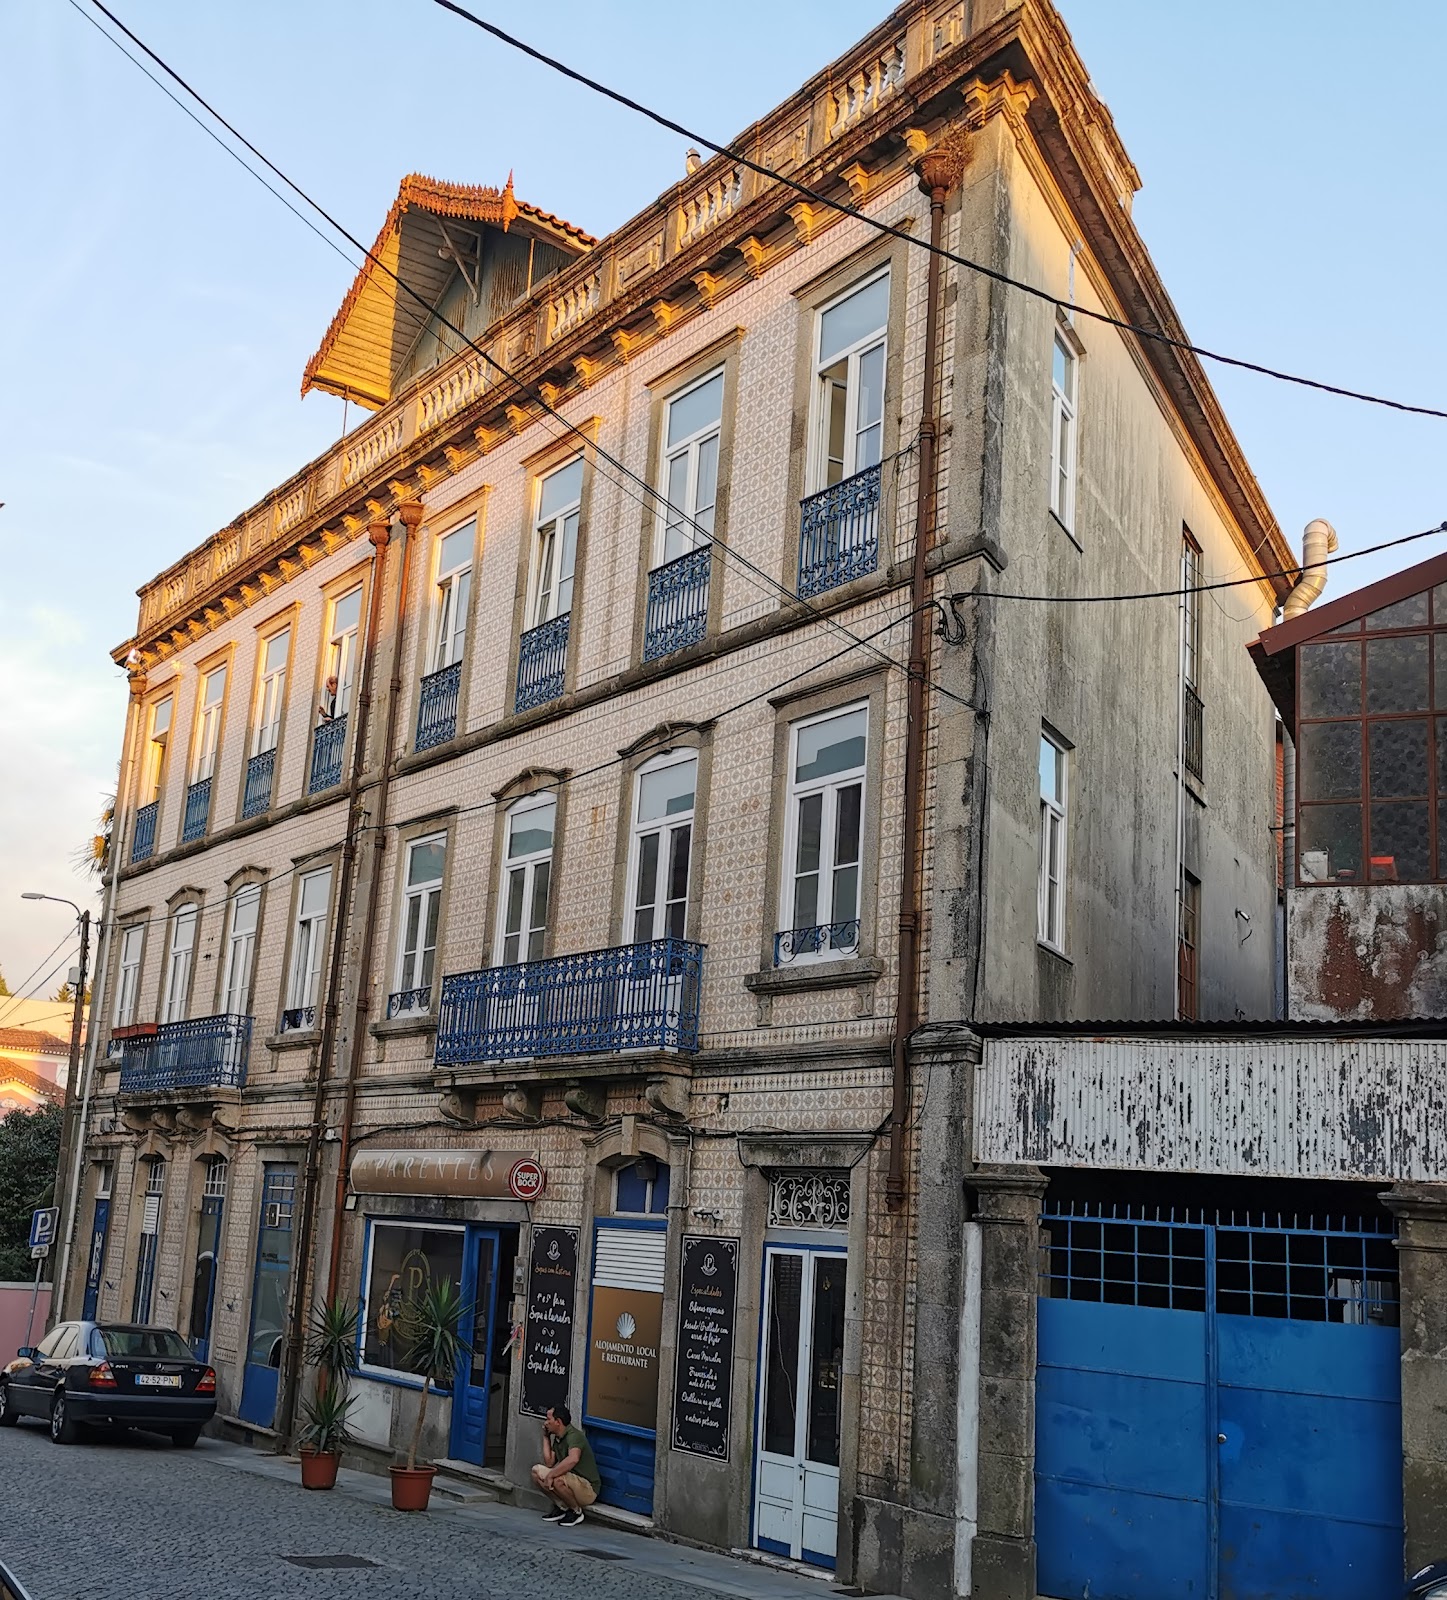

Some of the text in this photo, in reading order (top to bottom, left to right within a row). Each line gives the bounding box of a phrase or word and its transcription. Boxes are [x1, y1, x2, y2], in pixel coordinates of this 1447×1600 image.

[374, 1156, 496, 1181] PARENTES
[517, 1171, 538, 1180] SUPER
[517, 1178, 537, 1188] BOCK
[34, 1213, 51, 1243] P
[529, 1305, 543, 1324] Sopa
[595, 1340, 656, 1357] ALOJAMENTO LOCAL
[527, 1354, 542, 1374] Sopa
[602, 1353, 648, 1368] E RESTAURANTE
